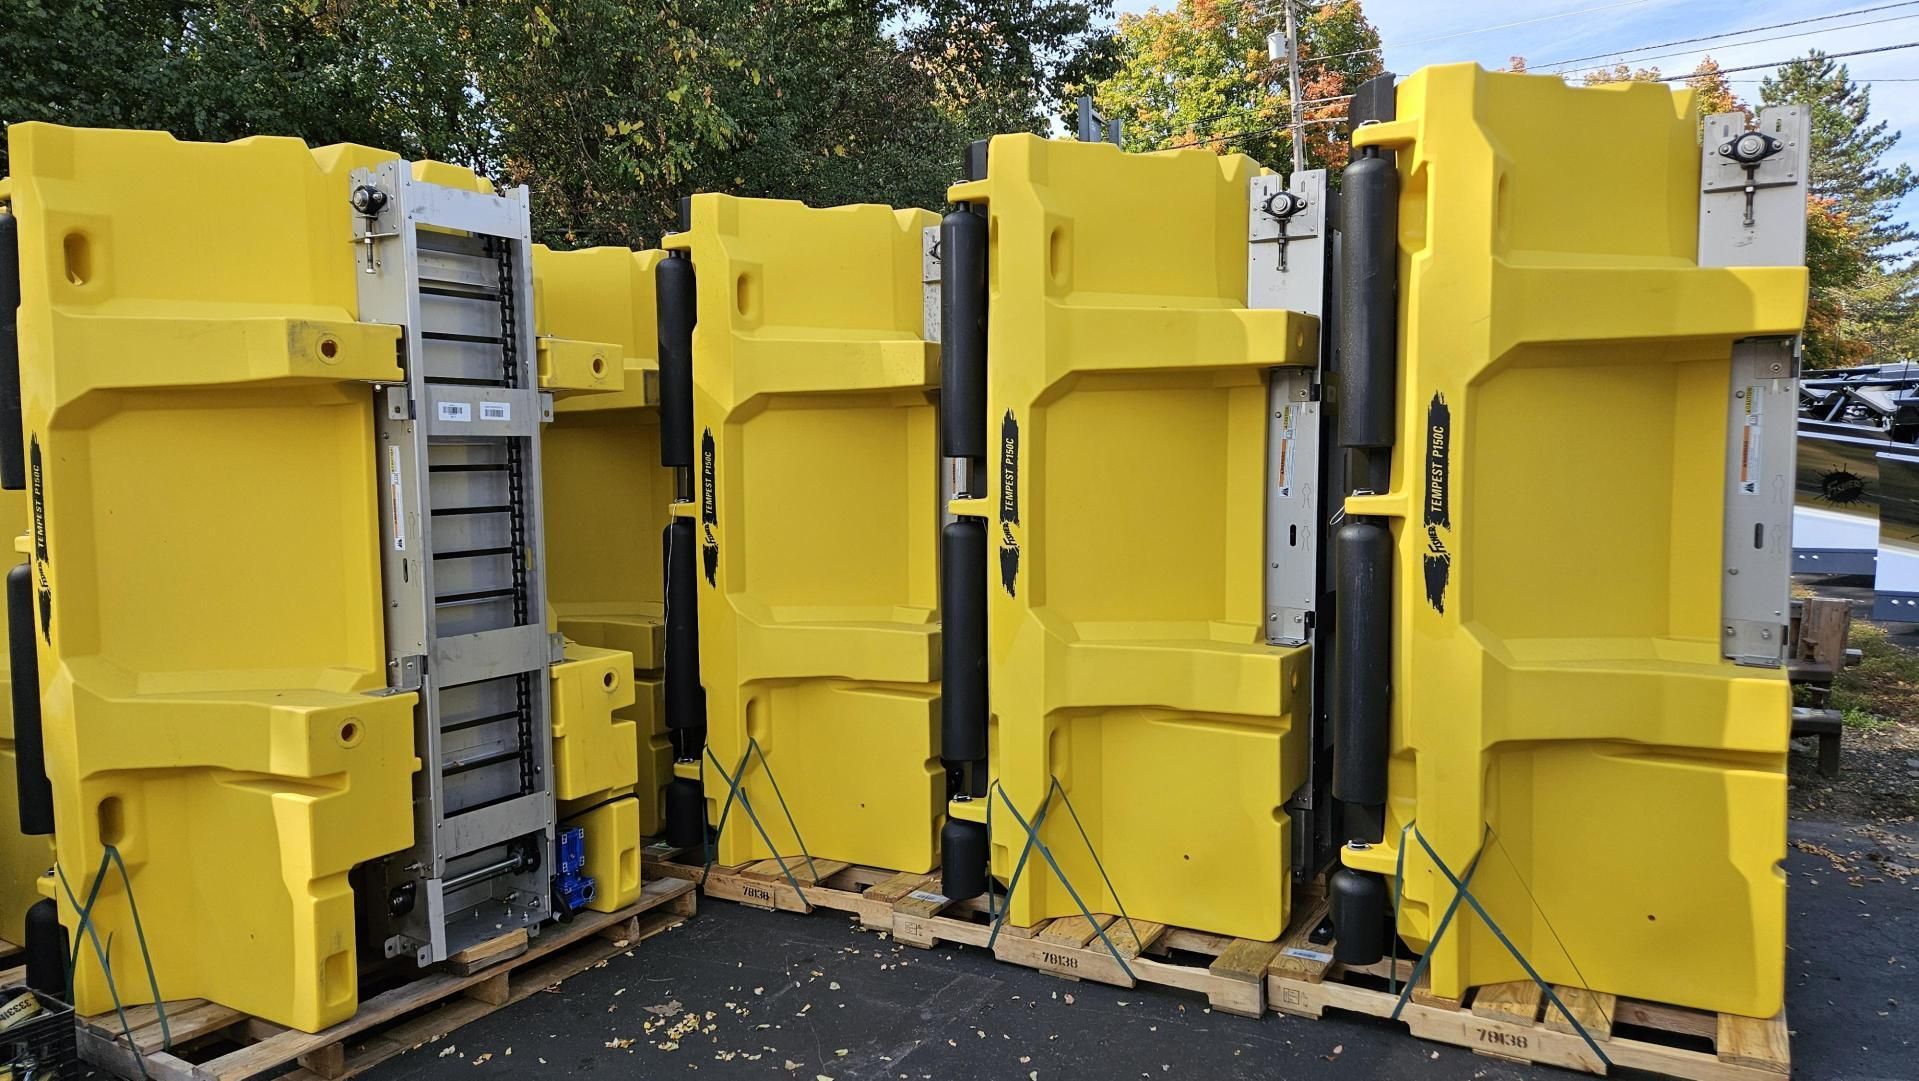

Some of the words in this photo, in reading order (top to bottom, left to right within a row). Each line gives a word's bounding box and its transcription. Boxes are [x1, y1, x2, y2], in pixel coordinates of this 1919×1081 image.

[1006, 437, 1014, 465] P150C
[1432, 425, 1444, 458] P150C
[705, 478, 713, 514] TEMPEST
[1005, 469, 1014, 511] TEMPEST
[1431, 461, 1443, 512] TEMPEST
[35, 500, 45, 549] TEMPEST
[1002, 522, 1017, 546] FISHER
[1427, 526, 1447, 554] FISHER
[742, 885, 770, 901] 78138
[1042, 951, 1079, 969] 78138
[1476, 1028, 1529, 1049] 78138
